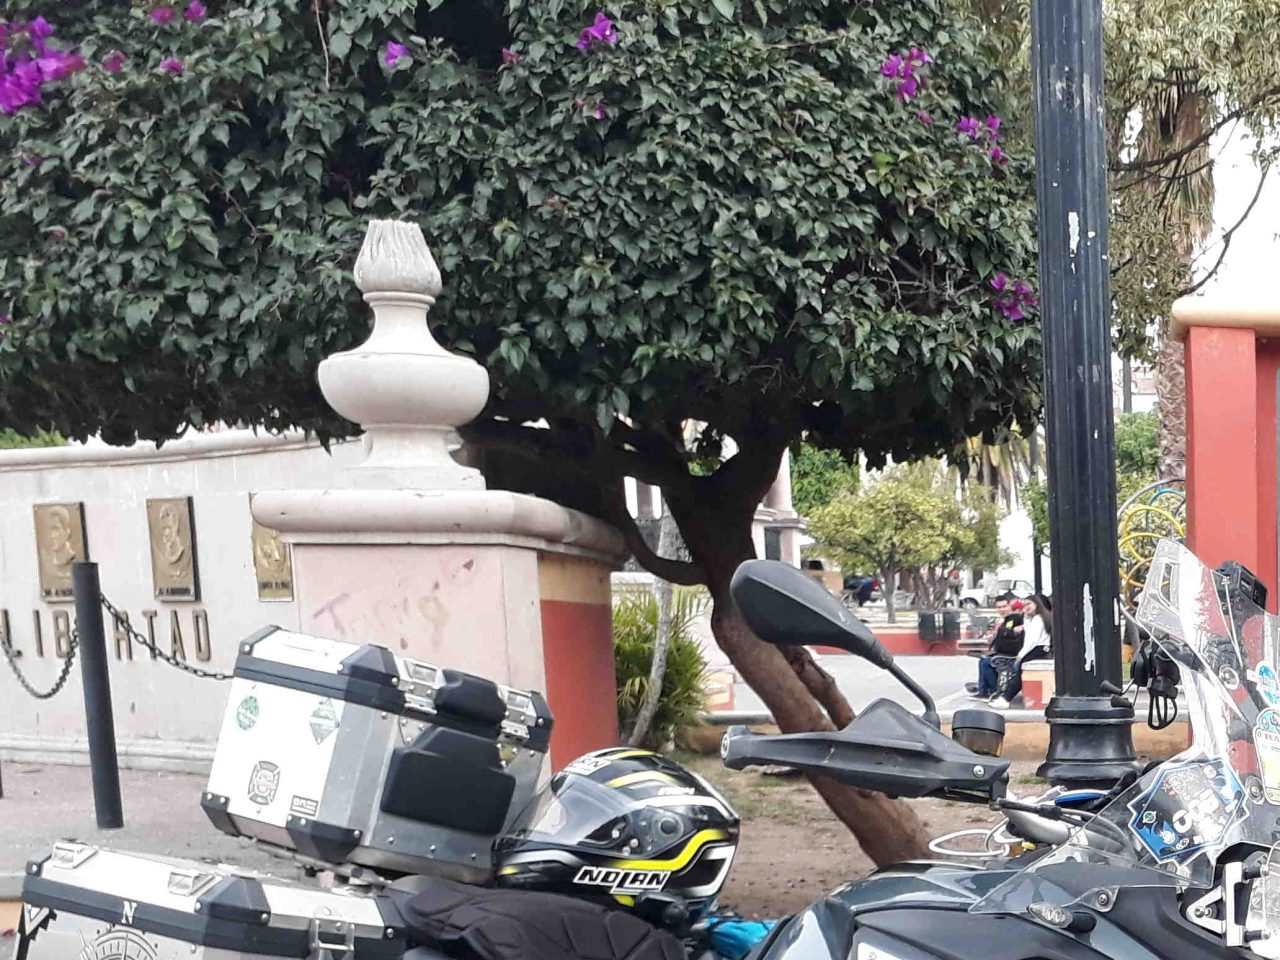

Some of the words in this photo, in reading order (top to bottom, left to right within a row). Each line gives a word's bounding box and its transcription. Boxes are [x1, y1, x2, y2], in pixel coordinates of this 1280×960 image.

[1, 609, 211, 662] LIBRTAD
[575, 867, 671, 894] NOLAN
[122, 900, 137, 925] N
